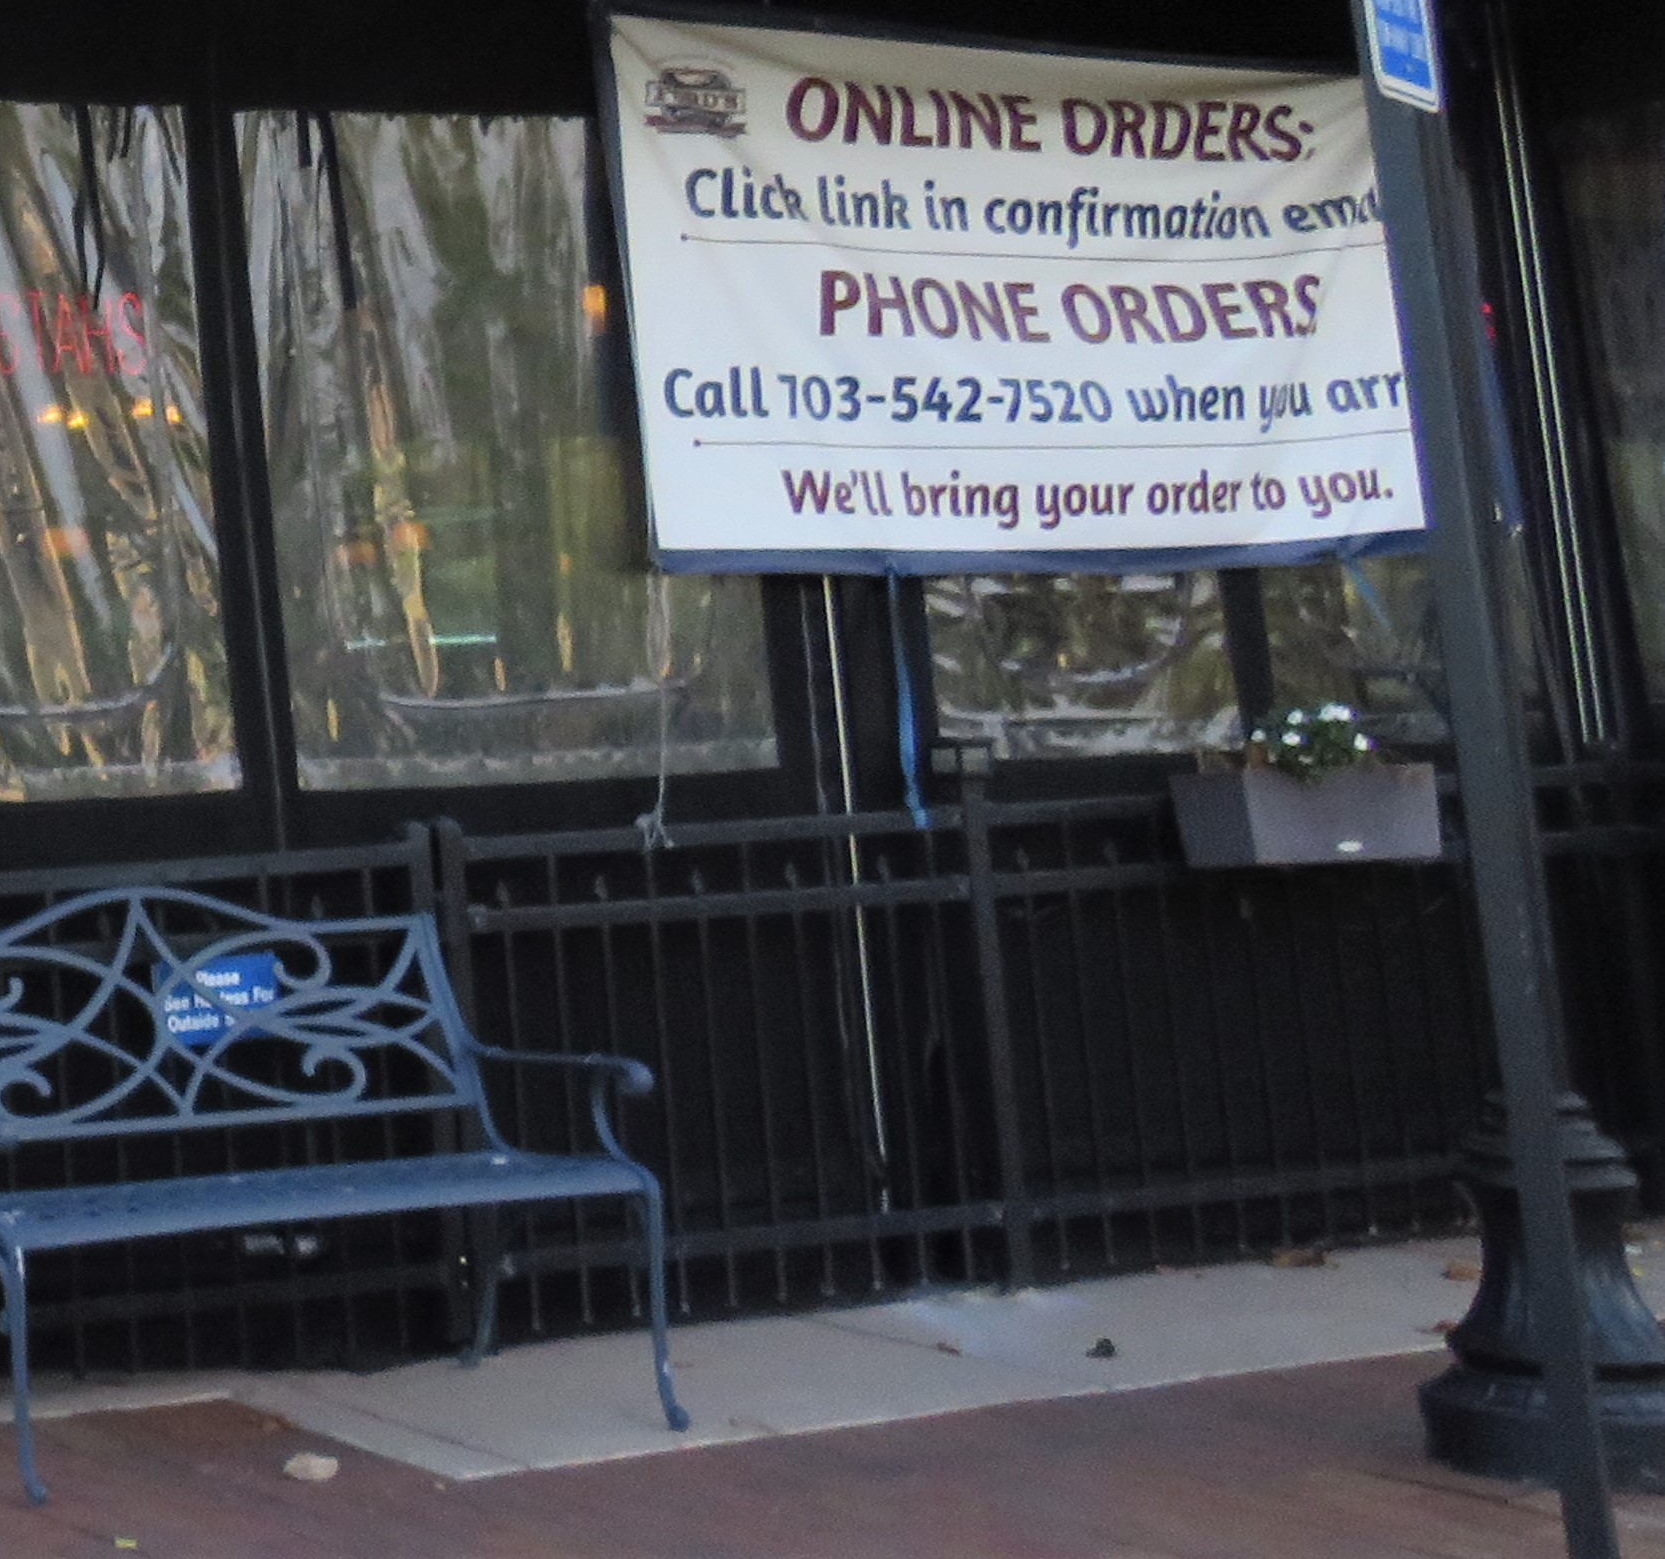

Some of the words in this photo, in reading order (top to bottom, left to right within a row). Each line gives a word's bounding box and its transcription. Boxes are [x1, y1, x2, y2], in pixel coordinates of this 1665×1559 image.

[786, 76, 1041, 152] ONLINE
[1062, 97, 1315, 162] ORDERS:
[684, 166, 809, 222] Click
[817, 173, 911, 230] link
[924, 179, 969, 231] in
[983, 187, 1270, 249] confirmation
[819, 269, 1051, 344] PHONE
[1060, 274, 1321, 344] ORDERS
[663, 366, 769, 419] Call
[775, 373, 1112, 424] 703-542-7520
[1126, 374, 1246, 424] when
[1258, 380, 1312, 434] you
[781, 469, 892, 517] We'll
[901, 469, 1020, 531] bring
[1036, 481, 1134, 531] your
[1146, 469, 1242, 516] order
[1250, 471, 1287, 511] to
[1298, 468, 1394, 519] you.
